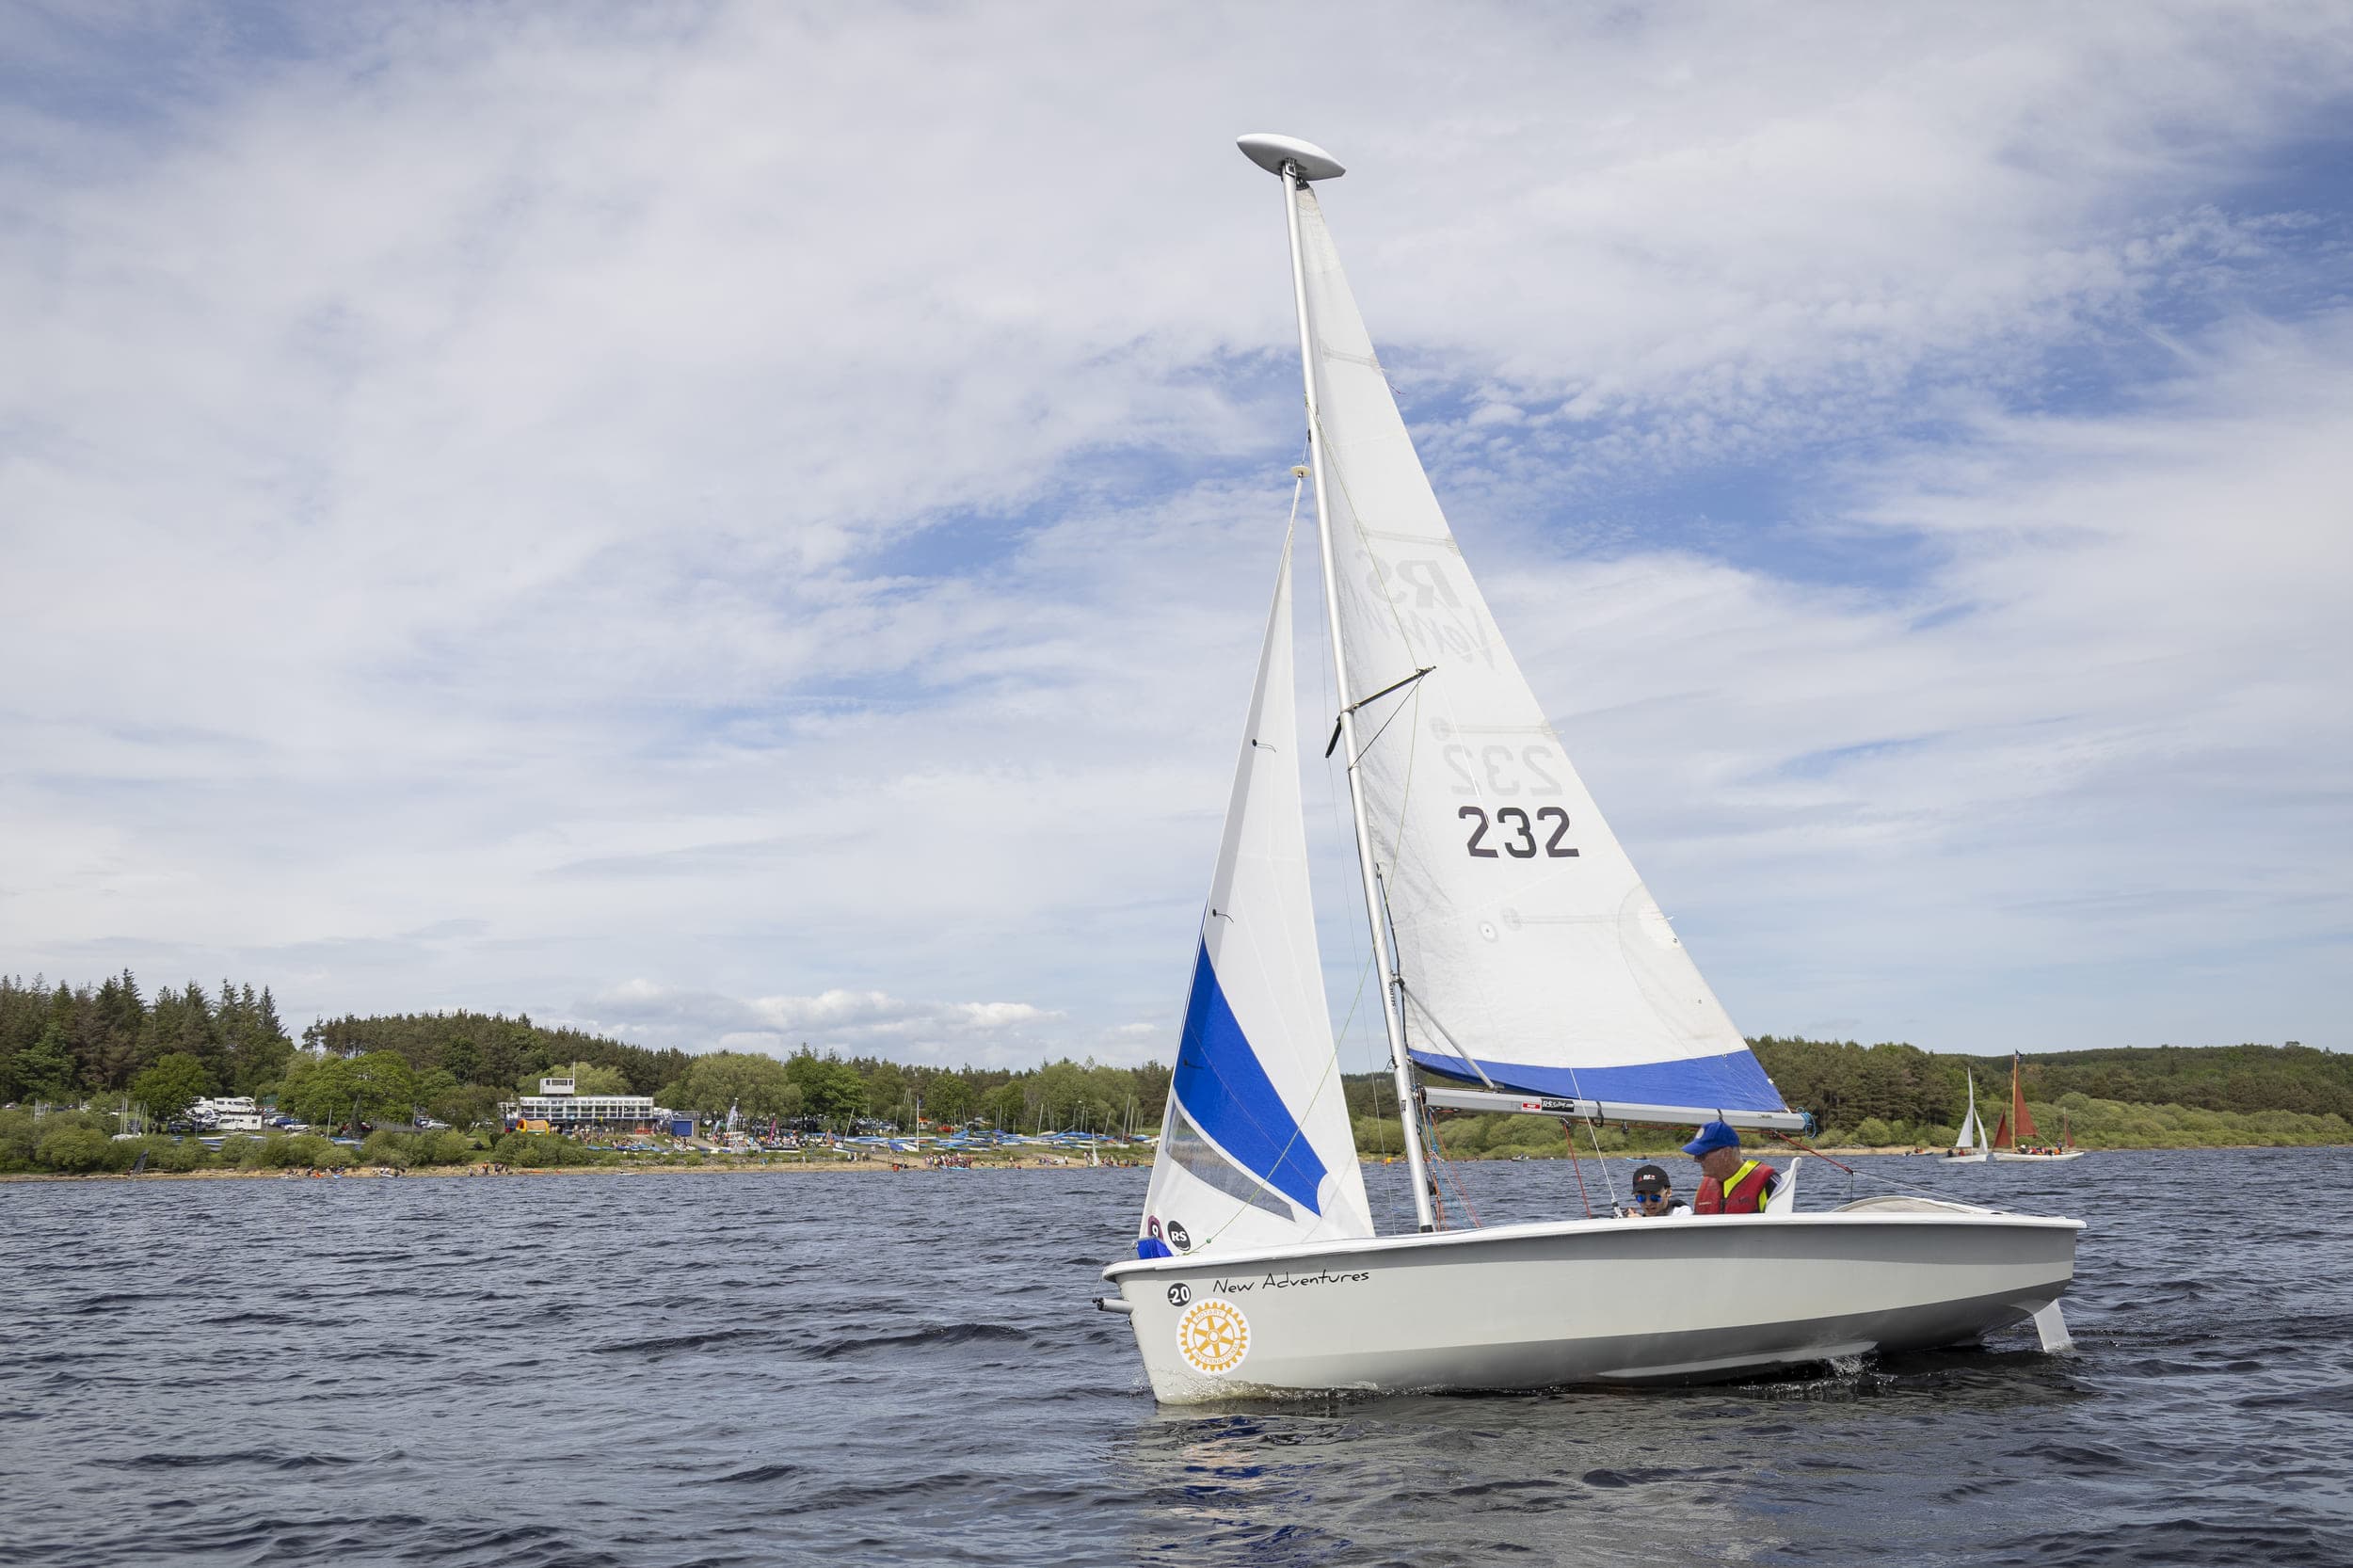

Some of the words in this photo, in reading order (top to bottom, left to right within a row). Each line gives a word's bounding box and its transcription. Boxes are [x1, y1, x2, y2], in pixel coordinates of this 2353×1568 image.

[1458, 806, 1580, 859] 232
[1170, 1231, 1188, 1241] RS
[1212, 1278, 1256, 1294] New
[1262, 1269, 1370, 1290] Adventures
[1169, 1287, 1191, 1304] 20
[1195, 1309, 1223, 1321] ROTARY
